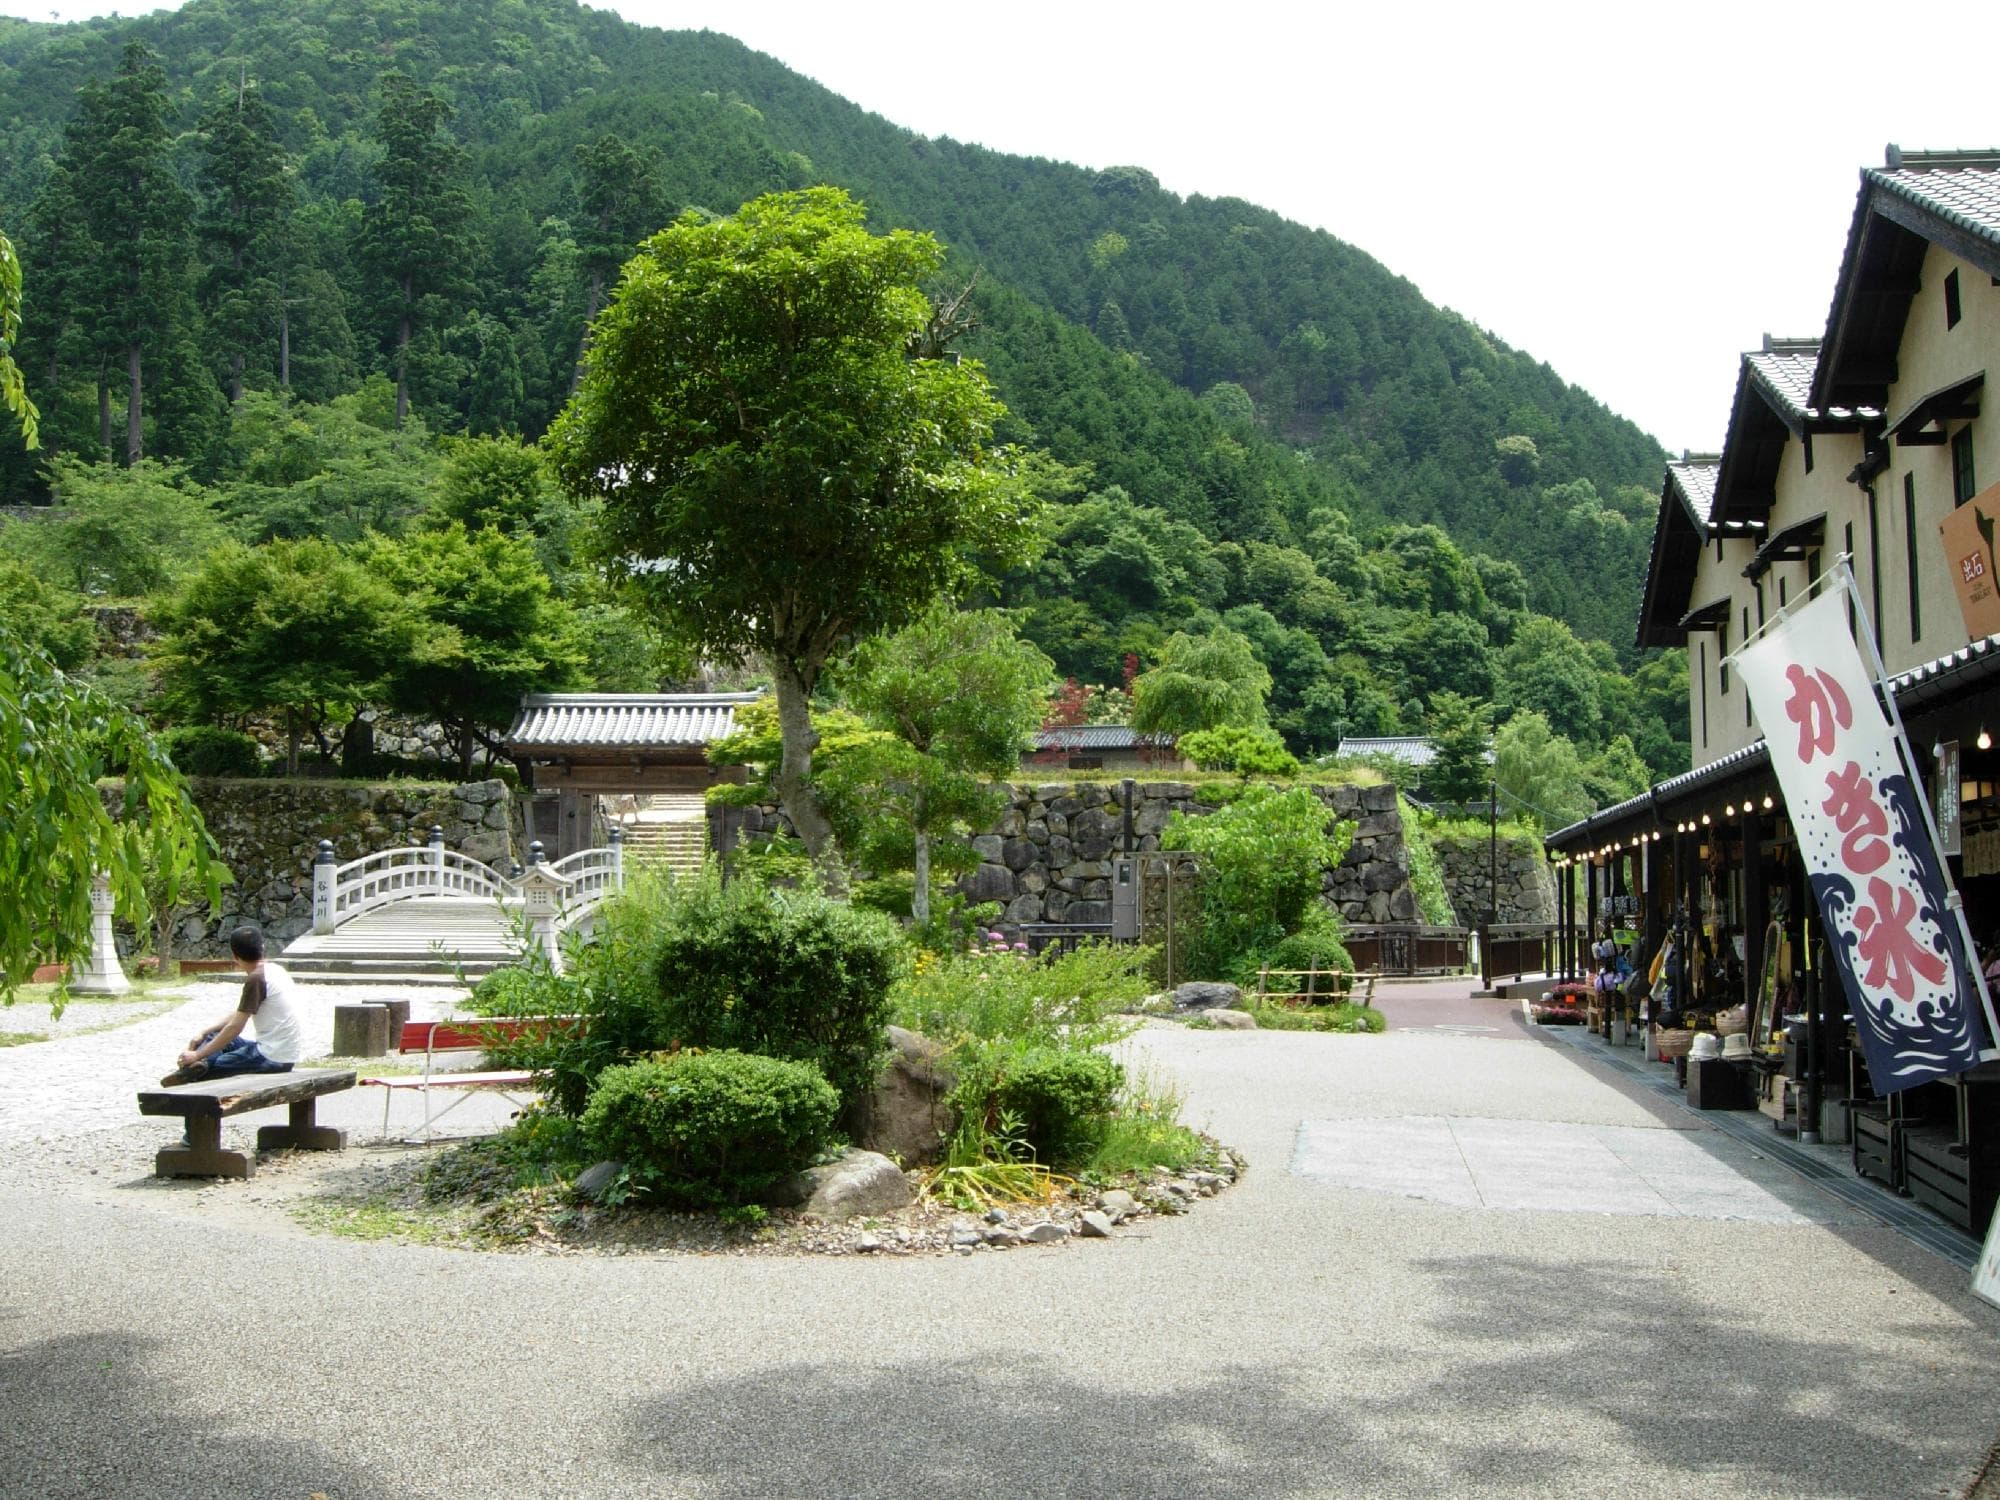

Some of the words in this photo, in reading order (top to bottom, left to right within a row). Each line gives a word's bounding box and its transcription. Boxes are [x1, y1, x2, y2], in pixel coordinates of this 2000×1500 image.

[1962, 552, 1983, 582] 出石
[1785, 664, 1947, 1003] かき氷
[317, 880, 328, 917] 谷山川
